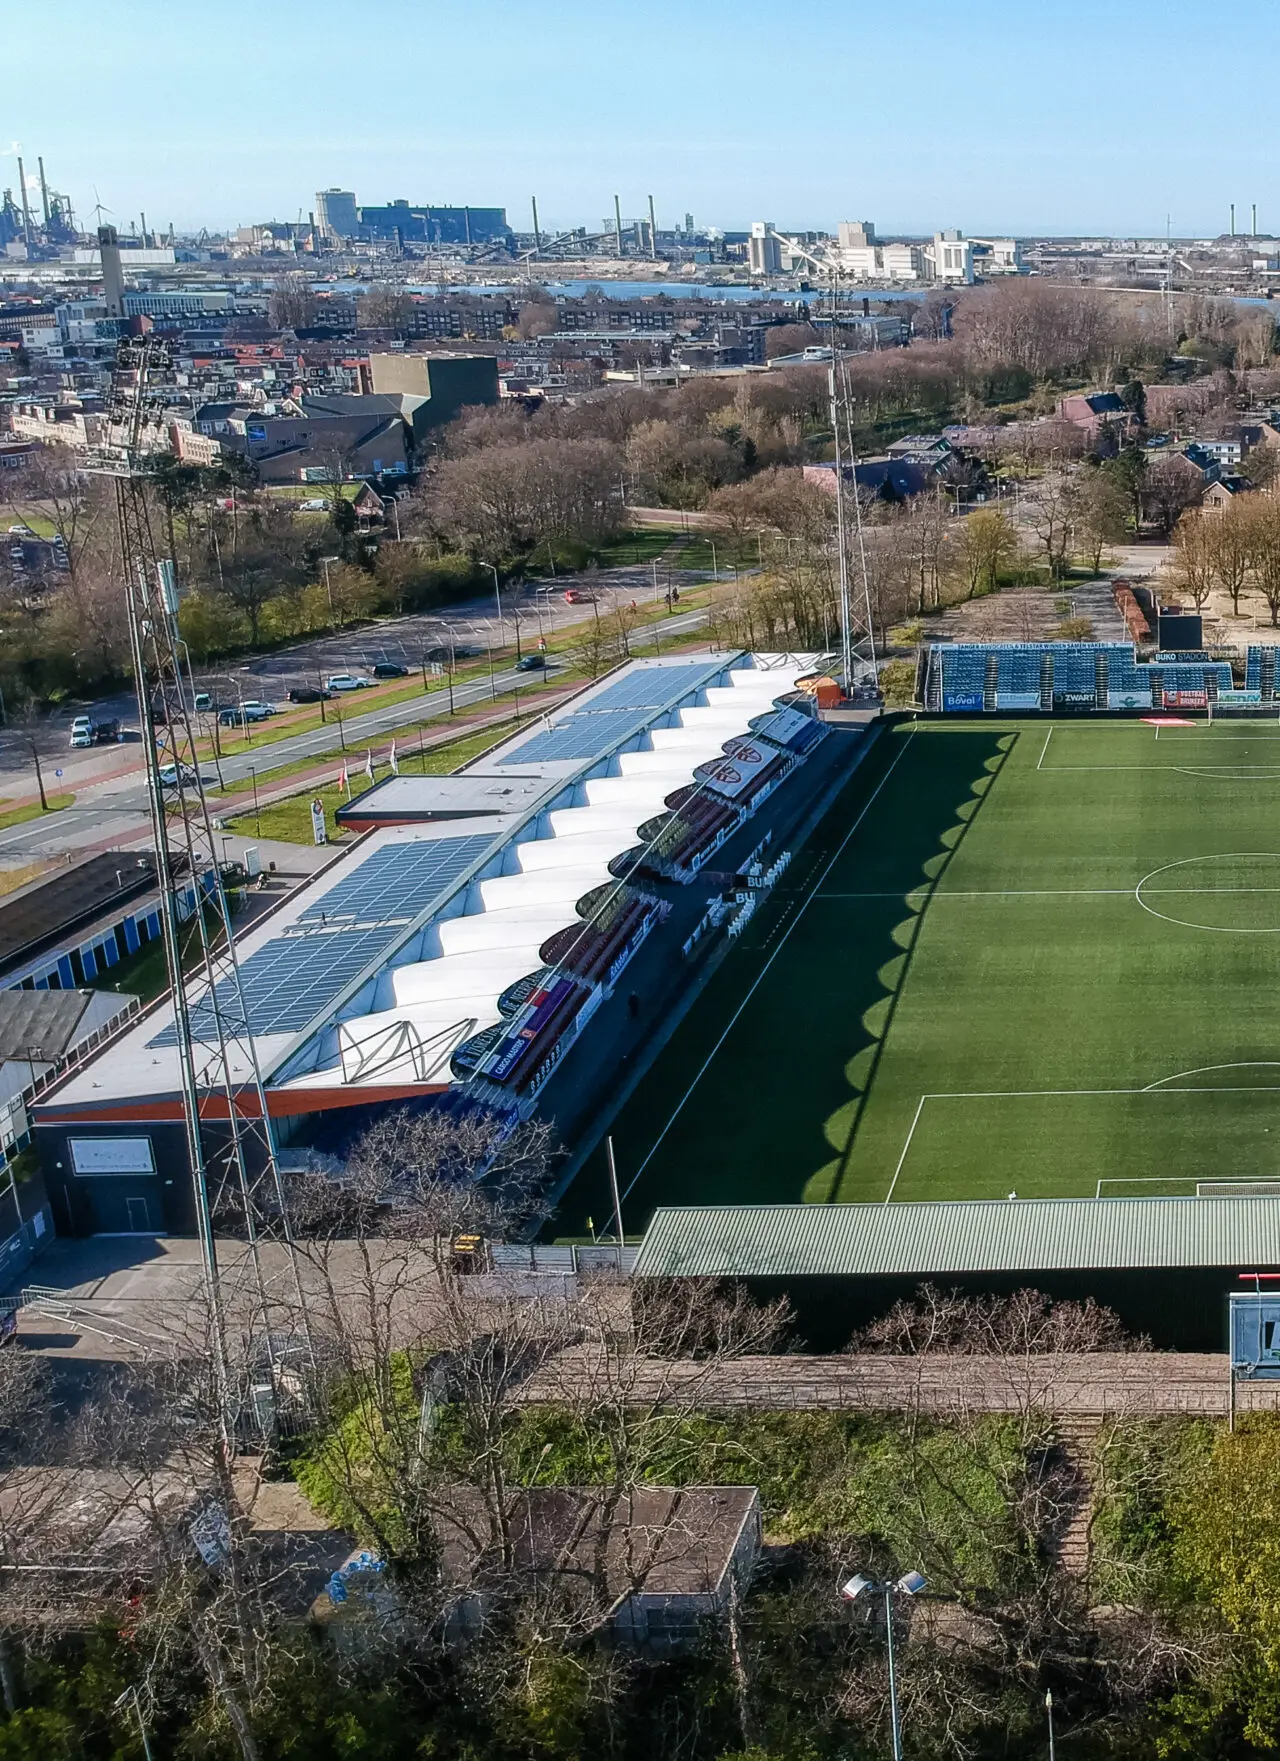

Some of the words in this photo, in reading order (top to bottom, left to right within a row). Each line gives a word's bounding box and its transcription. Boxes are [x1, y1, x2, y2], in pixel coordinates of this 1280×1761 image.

[1155, 653, 1177, 661] BUKO
[1177, 653, 1209, 661] STADION
[1065, 694, 1095, 702] ZWART
[494, 1055, 511, 1075] CARGO
[509, 1038, 526, 1063] MASTERS
